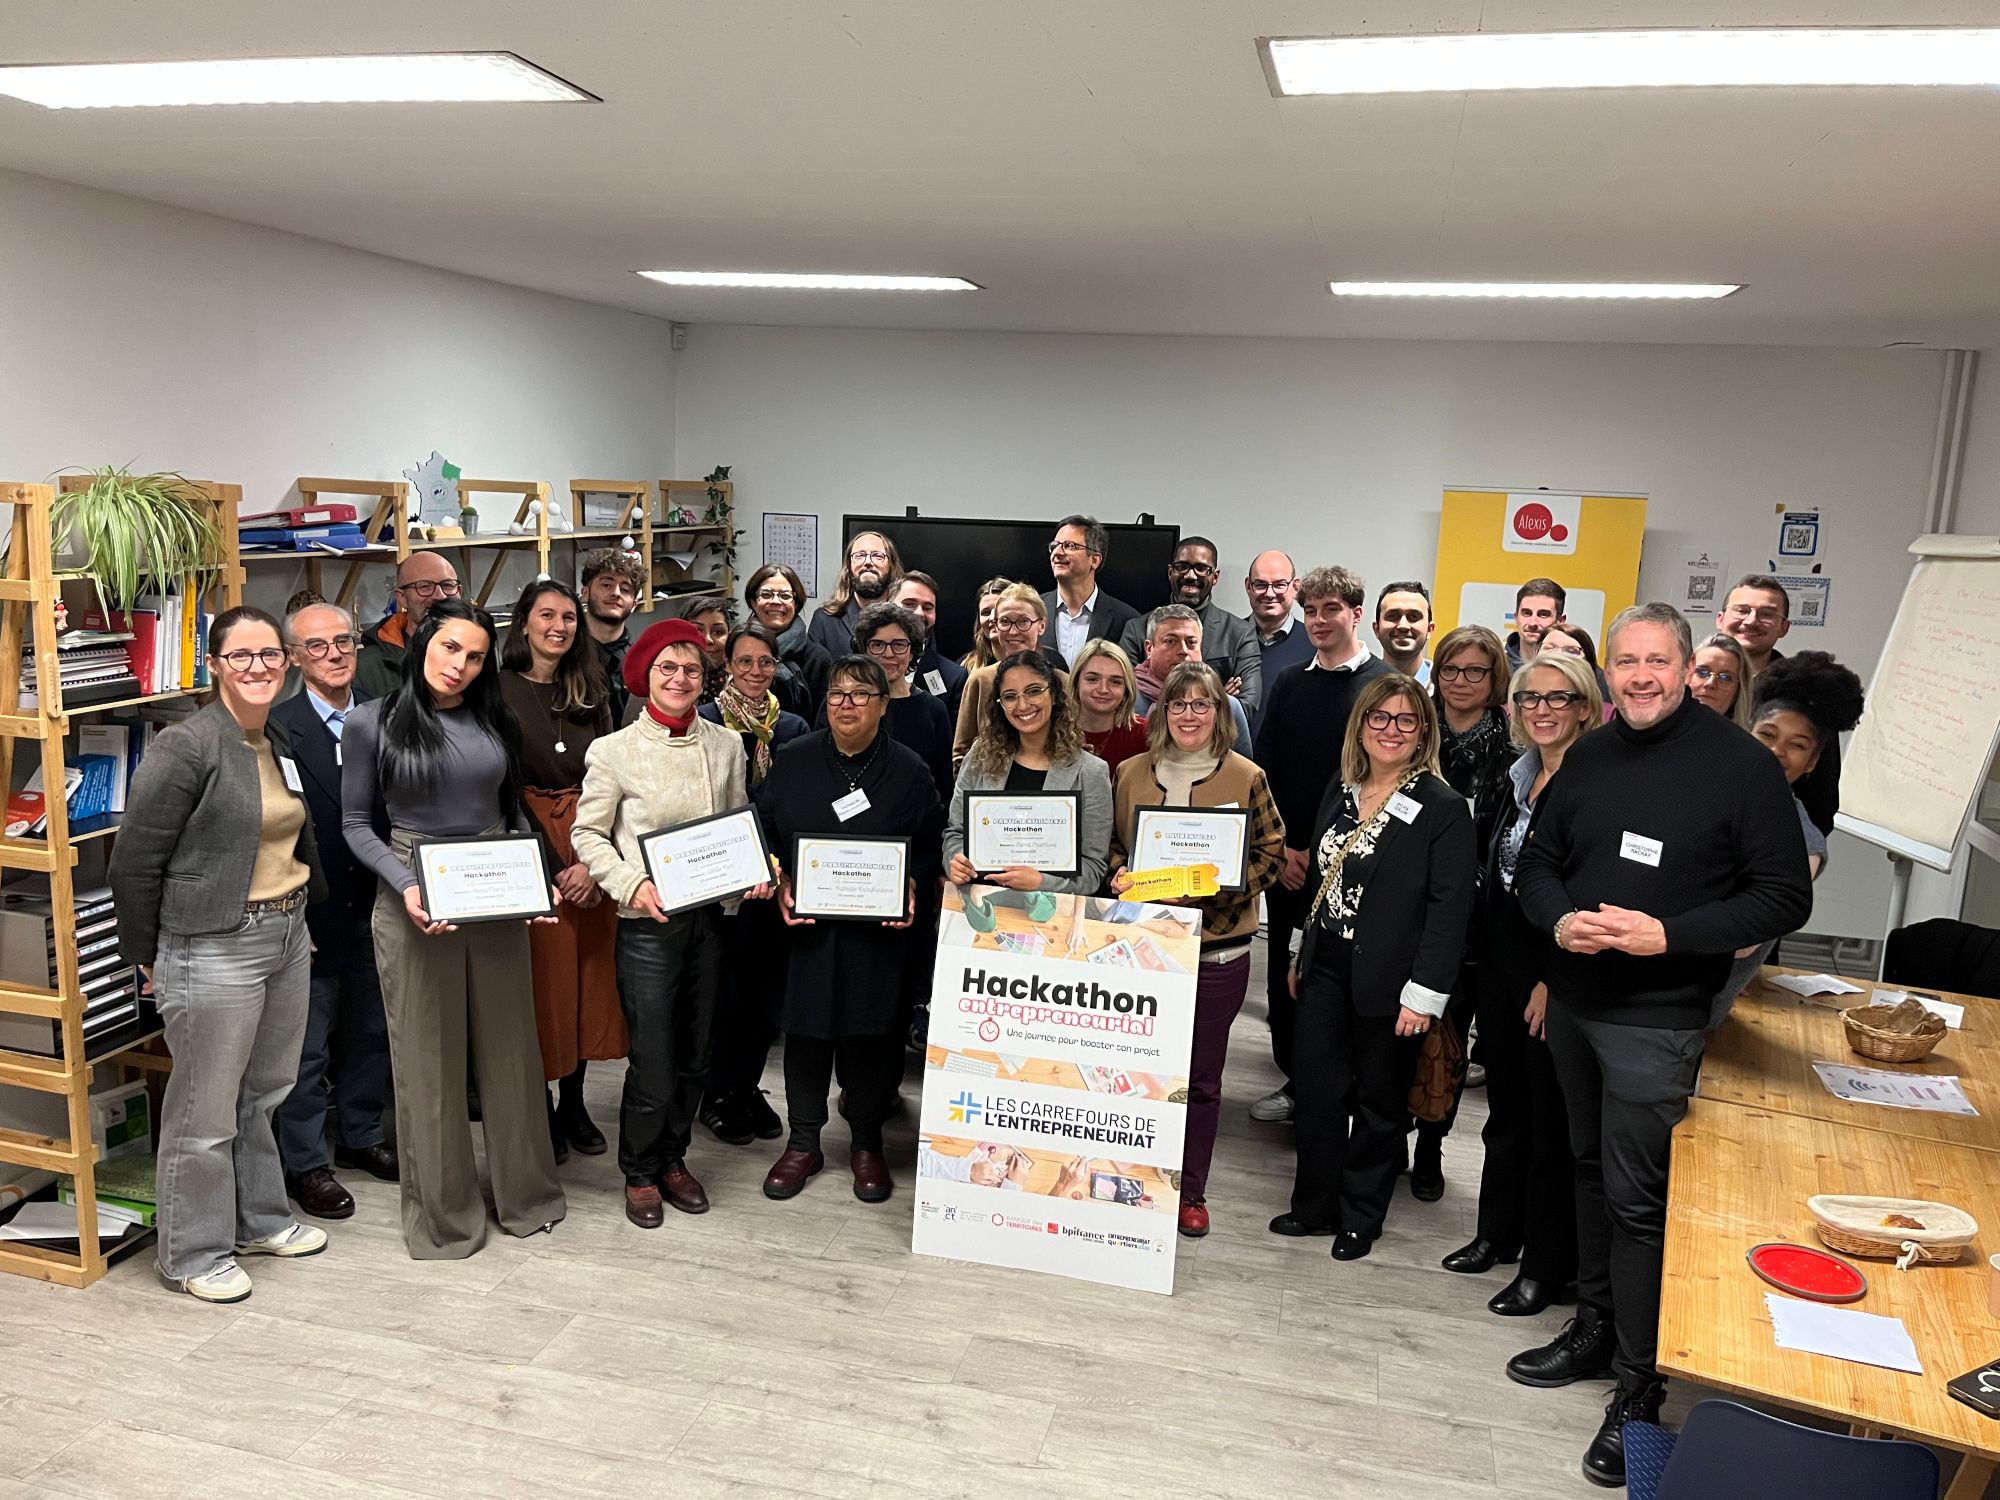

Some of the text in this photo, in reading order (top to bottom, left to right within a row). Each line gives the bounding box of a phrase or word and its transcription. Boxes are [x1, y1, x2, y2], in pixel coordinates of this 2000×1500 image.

[1518, 514, 1547, 531] Alexis
[688, 849, 727, 864] Hackathon
[464, 871, 507, 879] Hackathon
[1135, 877, 1172, 887] Hackathon
[962, 967, 1158, 1017] Hackathon
[958, 997, 1154, 1036] entrepreneurial
[1006, 1028, 1160, 1057] Une journée pour booster son projet
[986, 1095, 1156, 1133] LES CARREFOURS DE
[985, 1112, 1156, 1149] L'ENTREPRENEURIAT
[1006, 1221, 1043, 1233] TERRITOIRES
[1062, 1226, 1105, 1240] bpifrance
[1108, 1233, 1150, 1245] ENTREPRENEURIAT
